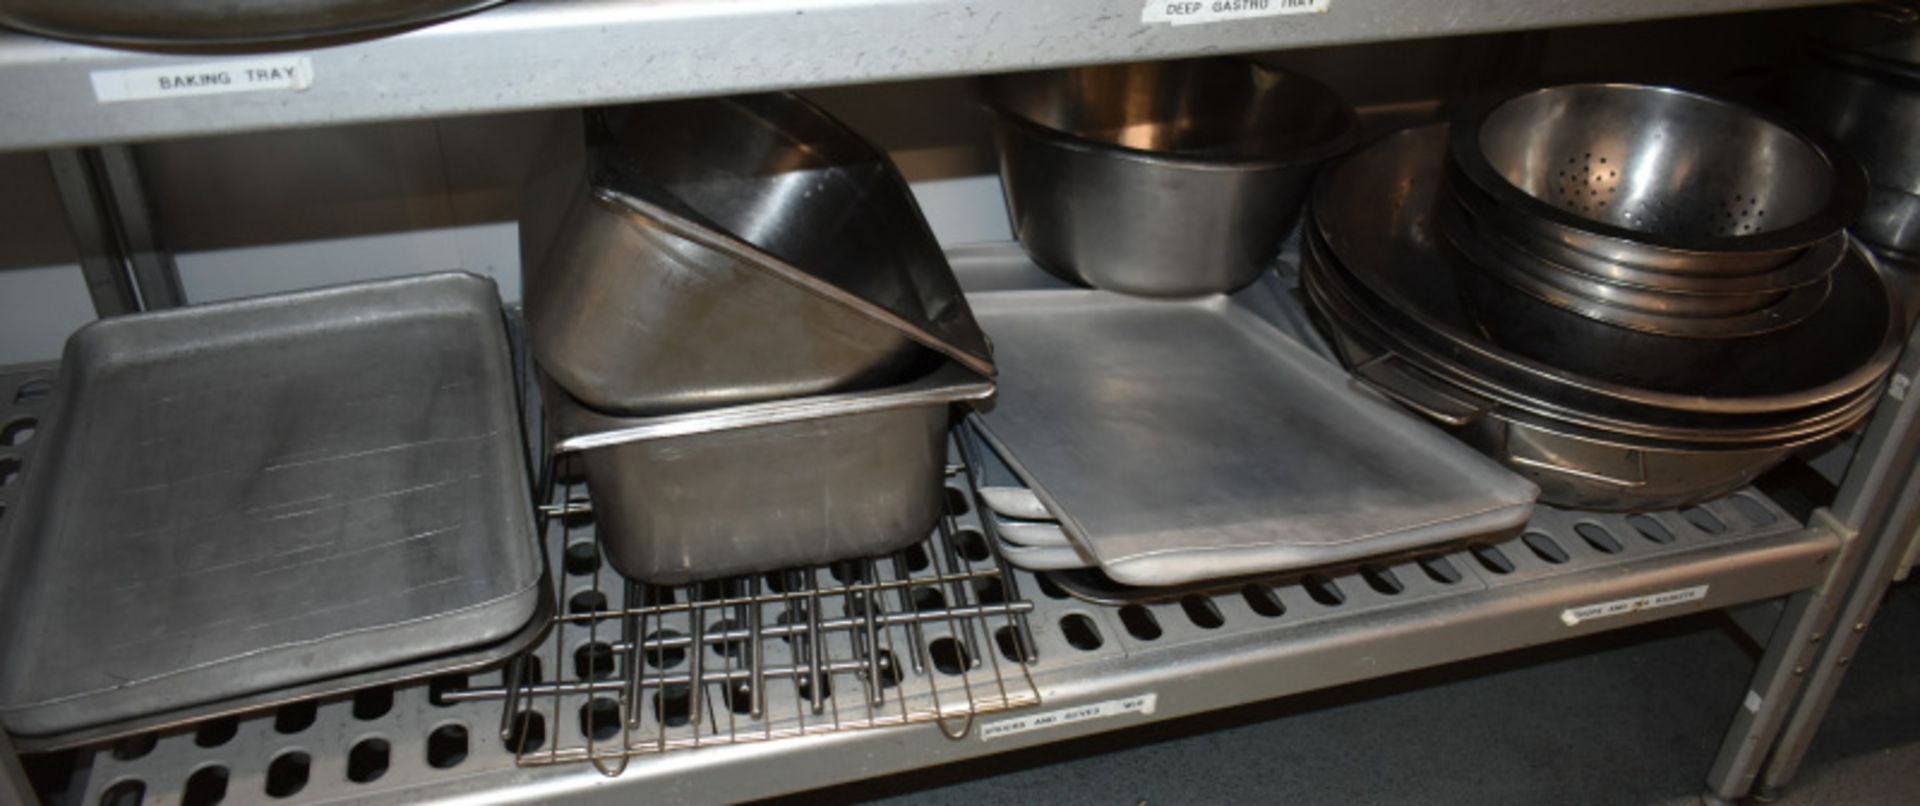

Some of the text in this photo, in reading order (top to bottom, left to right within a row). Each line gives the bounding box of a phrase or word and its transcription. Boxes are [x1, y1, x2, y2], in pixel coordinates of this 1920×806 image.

[1166, 2, 1203, 16] DEEP
[1212, 0, 1268, 13] GASTRO
[158, 66, 296, 90] BAKING TRAY
